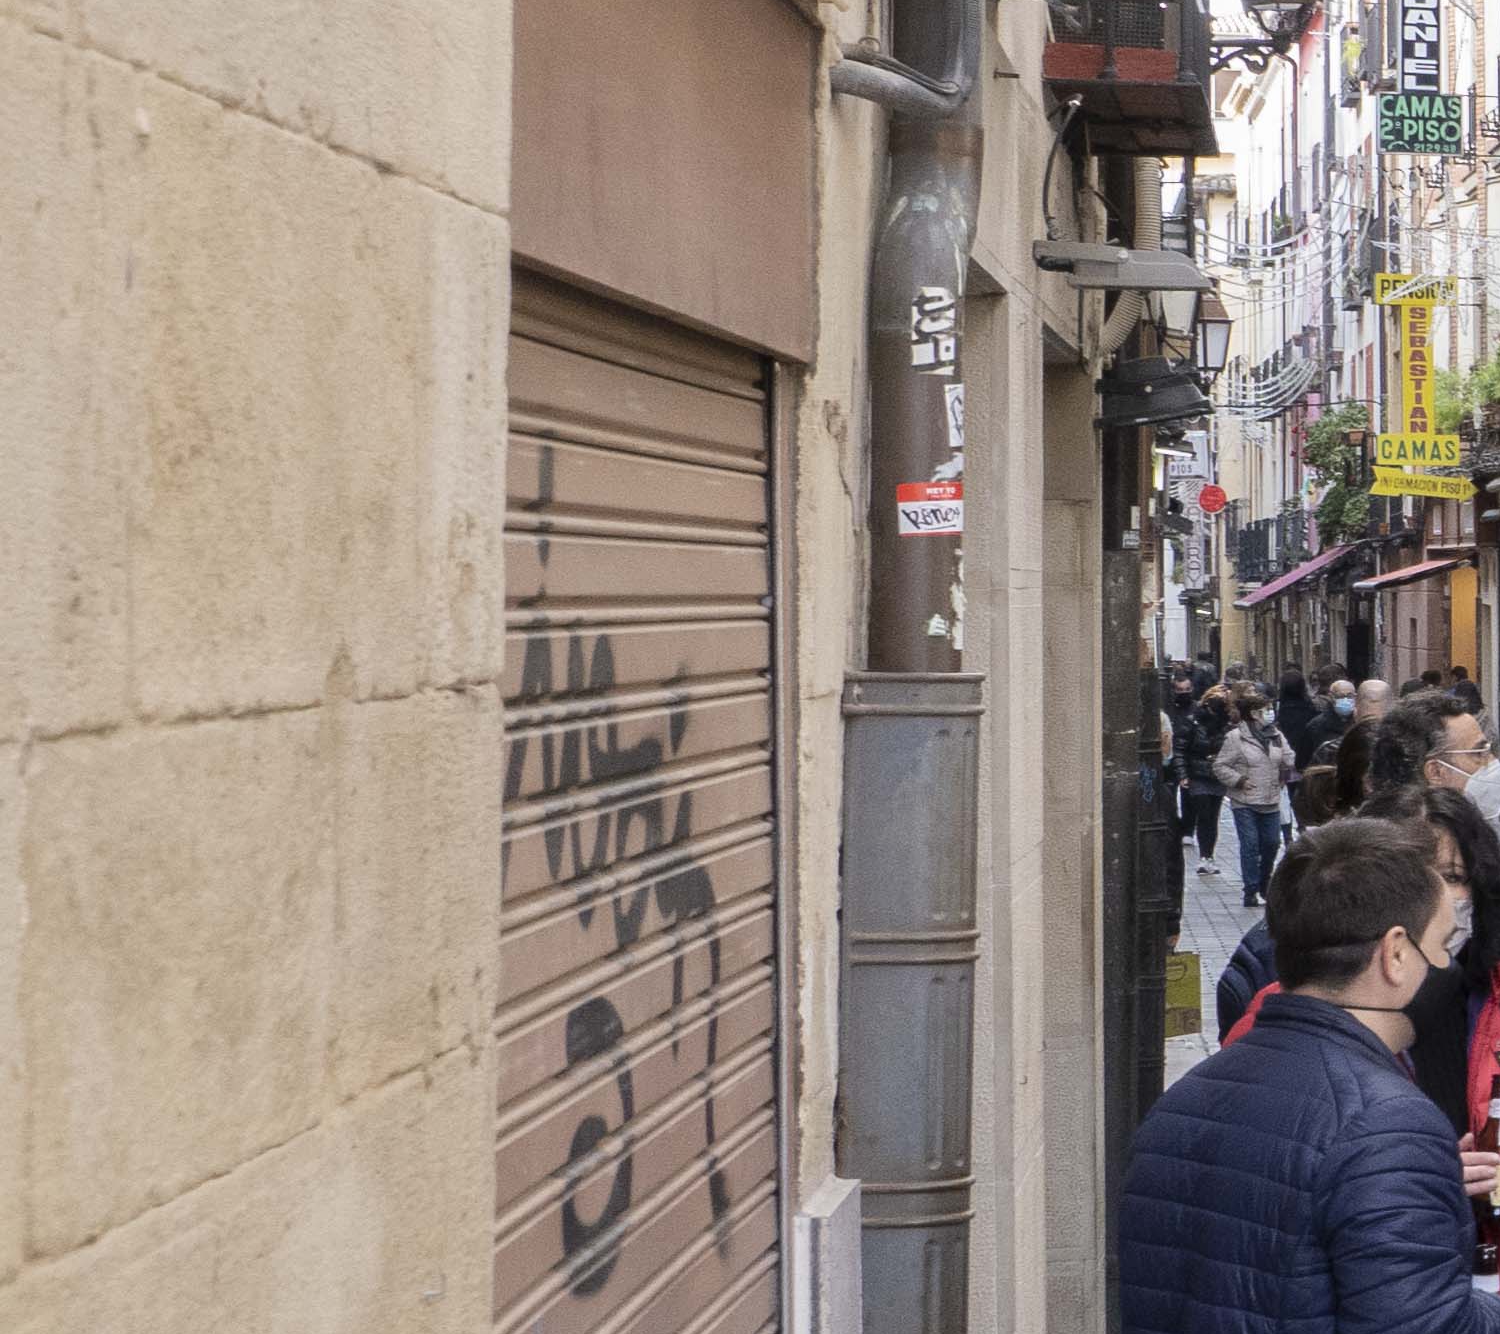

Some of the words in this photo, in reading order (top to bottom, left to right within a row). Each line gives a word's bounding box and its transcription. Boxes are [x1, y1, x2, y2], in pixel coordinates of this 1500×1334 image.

[1380, 95, 1461, 118] CAMAS
[1403, 120, 1462, 142] PISO
[1409, 306, 1428, 433] SEBASTIAN
[1381, 440, 1457, 461] CAMAS
